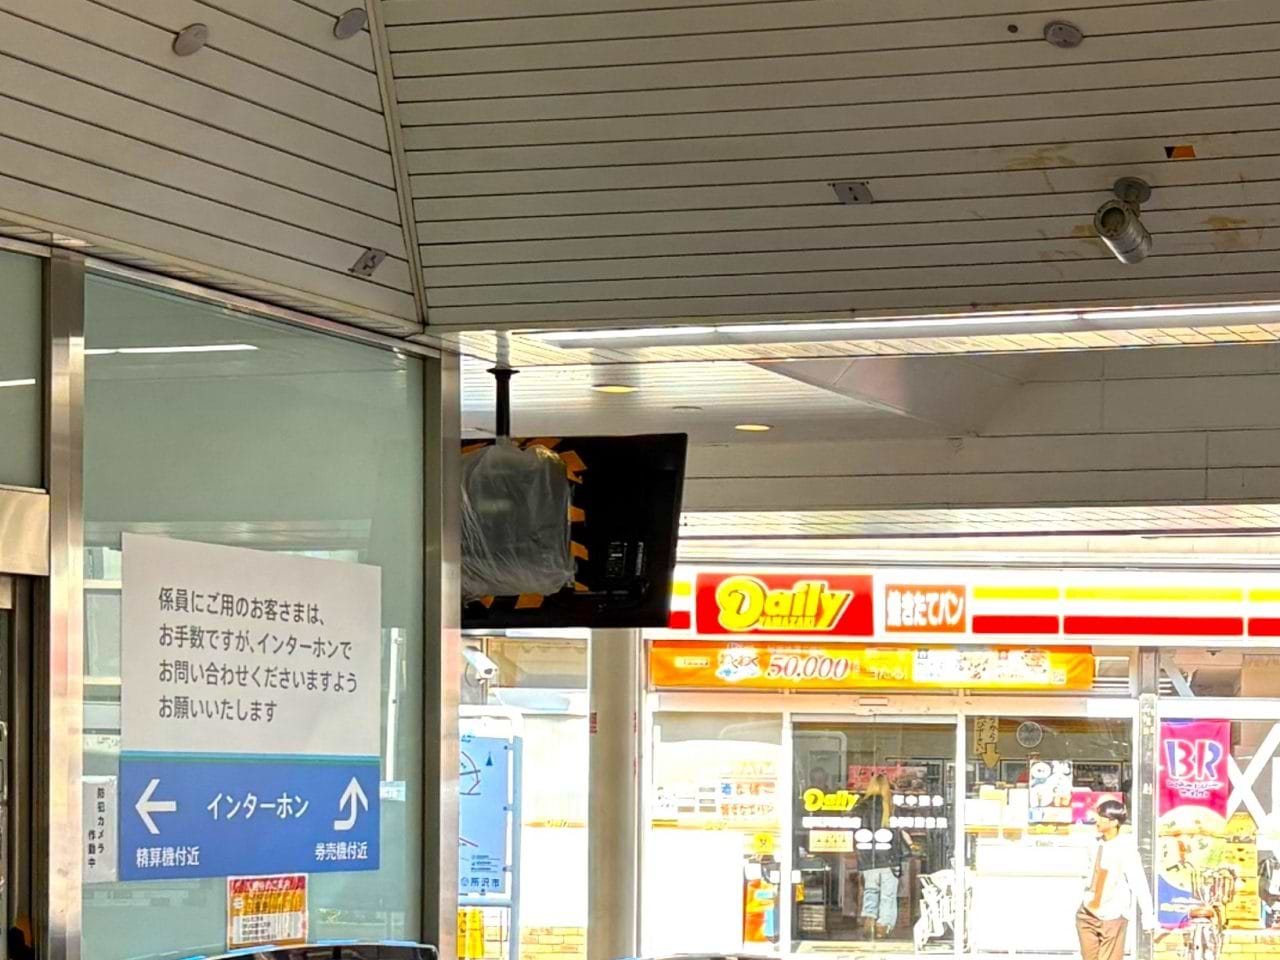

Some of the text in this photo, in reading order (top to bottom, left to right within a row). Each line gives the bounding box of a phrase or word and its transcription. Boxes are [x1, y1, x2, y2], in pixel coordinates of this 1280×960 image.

[158, 586, 325, 626] 係員にご用のお客さまは、
[716, 576, 852, 631] Daily
[158, 624, 352, 660] お手数ですが、インターホンで
[158, 659, 358, 694] お問い合わせくださいますよう
[158, 694, 278, 723] お願いいたします
[206, 792, 309, 821] インターホン
[135, 846, 200, 868] 精算機付近
[315, 841, 369, 861] 券売機付近
